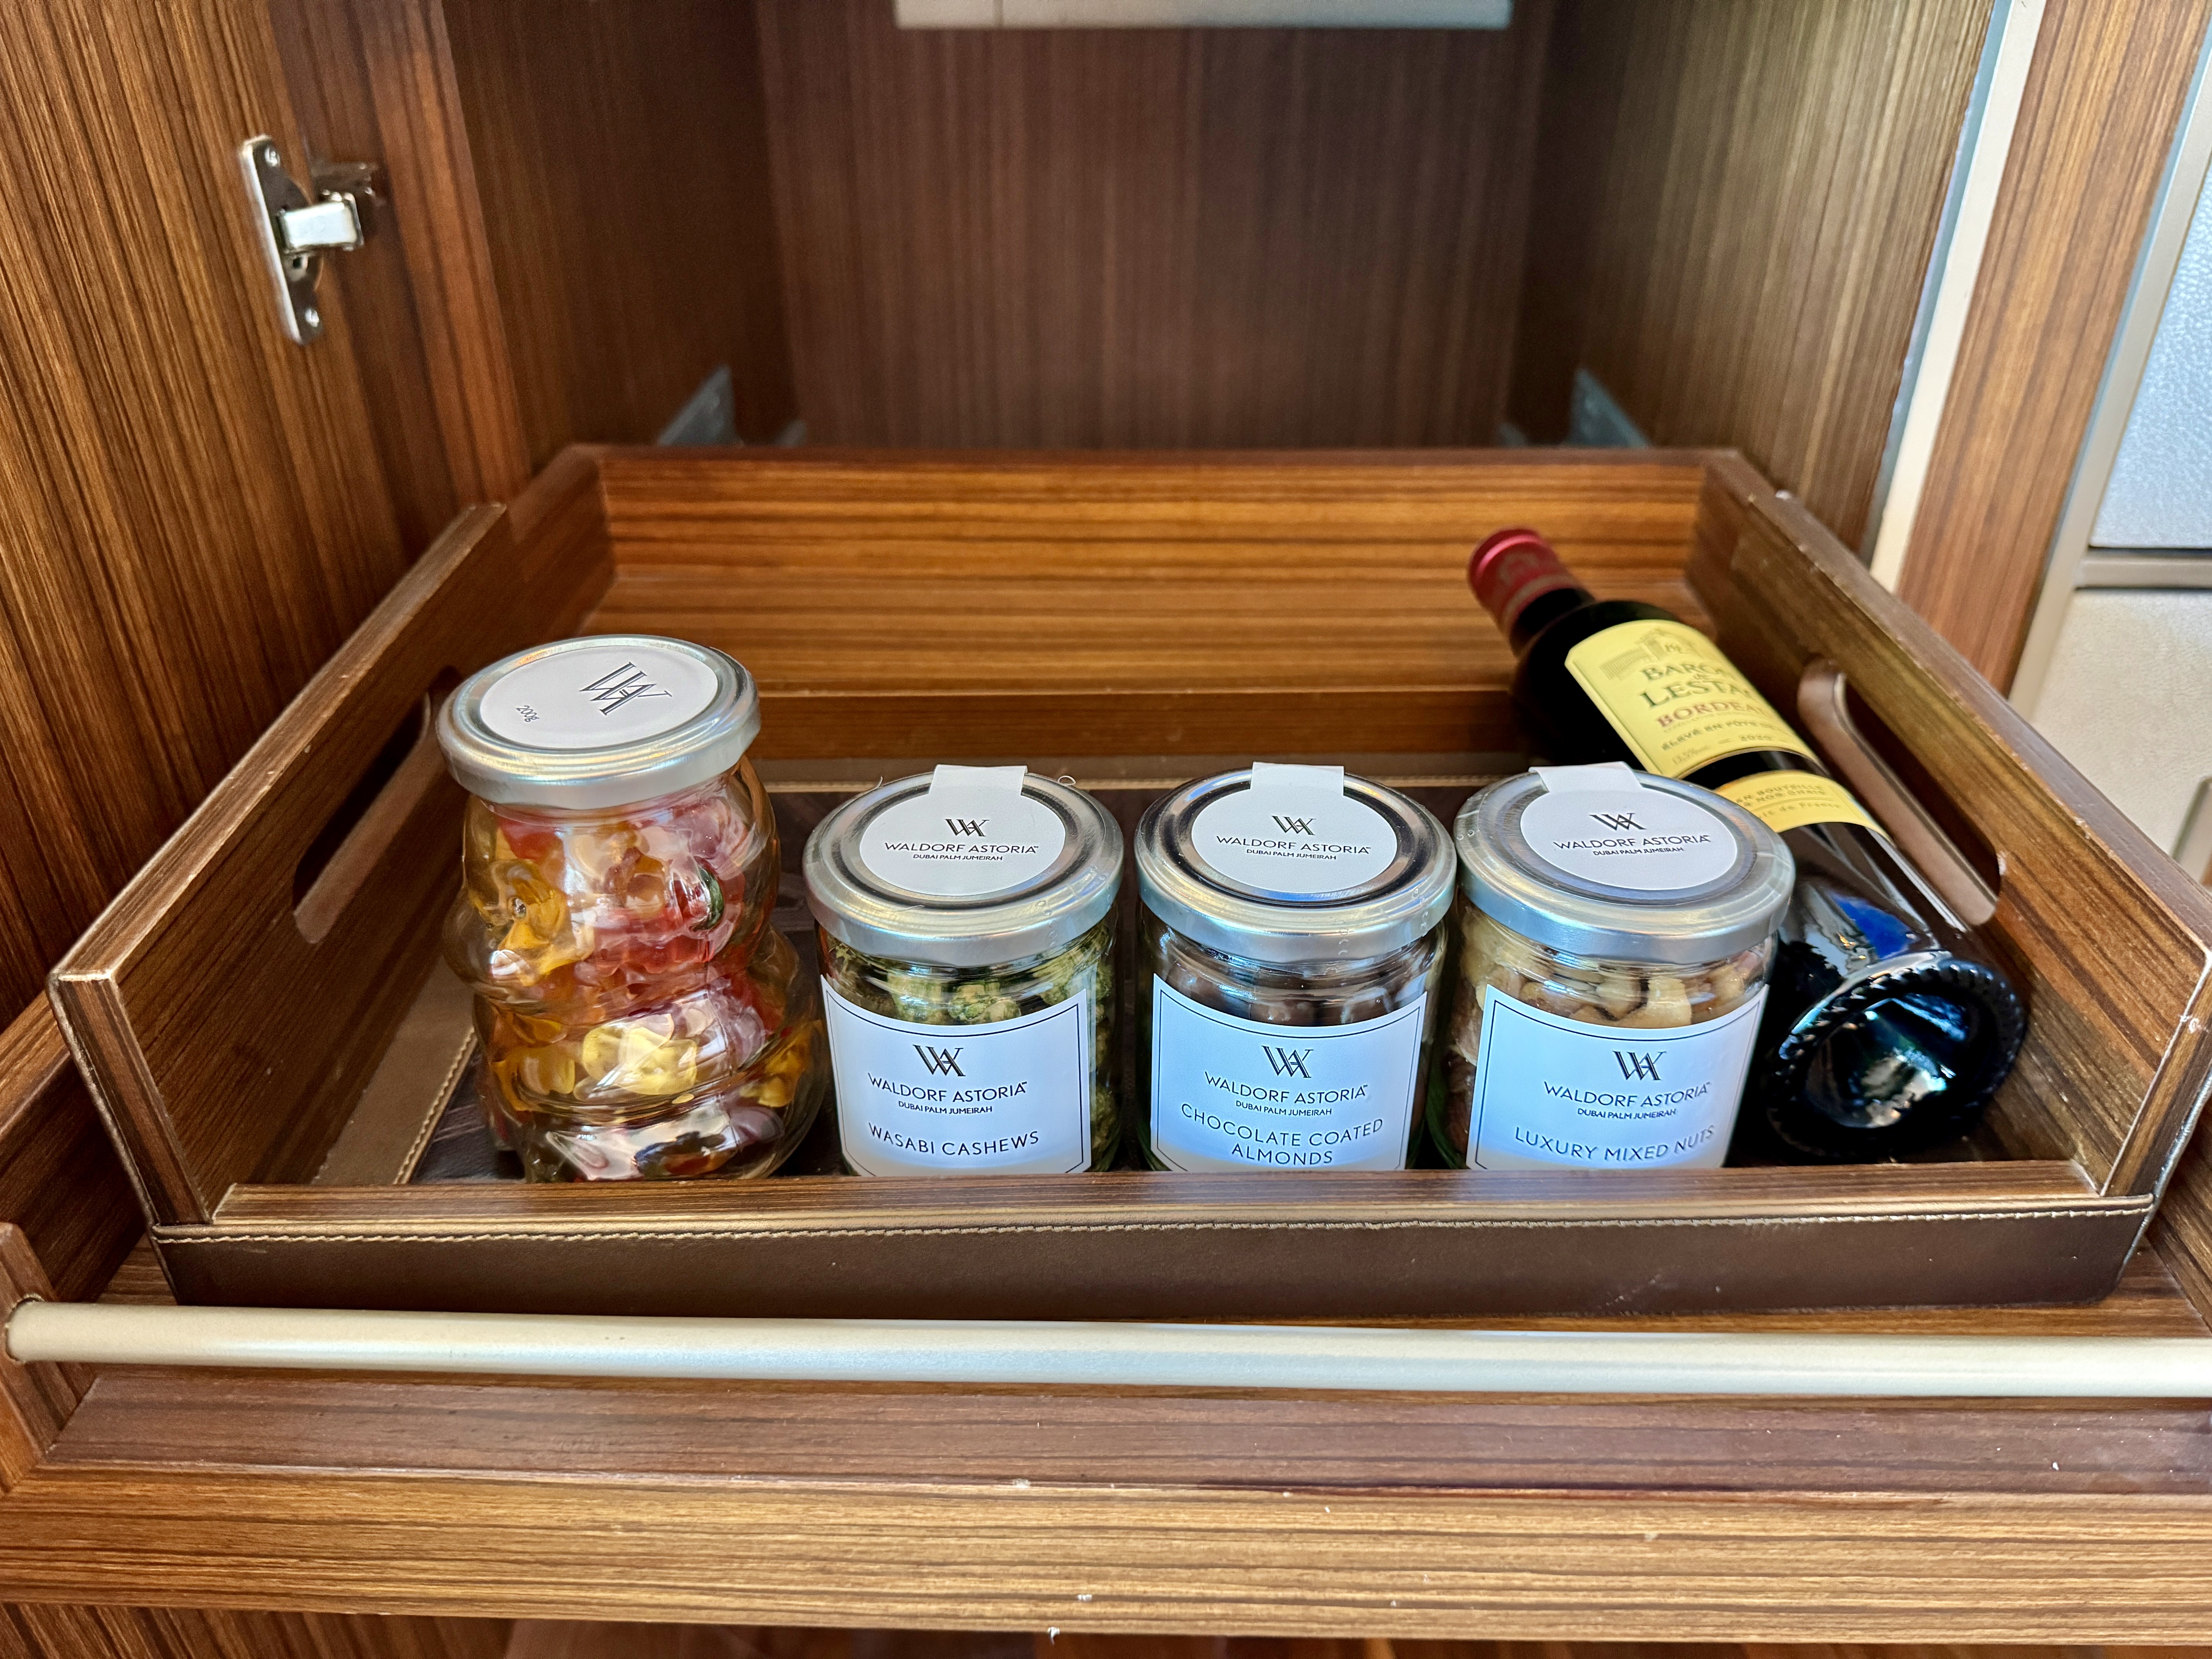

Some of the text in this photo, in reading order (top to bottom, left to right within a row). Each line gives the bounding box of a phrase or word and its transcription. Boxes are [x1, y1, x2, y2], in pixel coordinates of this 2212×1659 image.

[516, 704, 540, 723] 200g
[885, 842, 965, 853] WALDORF
[1216, 835, 1297, 850] WALDORF
[1553, 838, 1635, 849] WALDORF
[868, 1072, 947, 1102] WALDORF
[1204, 1071, 1290, 1103] WALDORF
[1544, 1081, 1638, 1107] WALDORF
[898, 1100, 993, 1115] DUBAI PALM JUMEIRAH
[1235, 1100, 1332, 1116] DUBAI PALM JUMEIRAH
[1577, 1108, 1606, 1118] DUBAI
[1633, 1109, 1676, 1120] JUMEIRAH
[1182, 1103, 1383, 1147] CHOCOLATE COATED
[868, 1122, 1039, 1156] WASABI CASHEWS
[1515, 1125, 1716, 1161] LUXURY MIXED NUTS
[1231, 1143, 1333, 1166] ALMONDS
